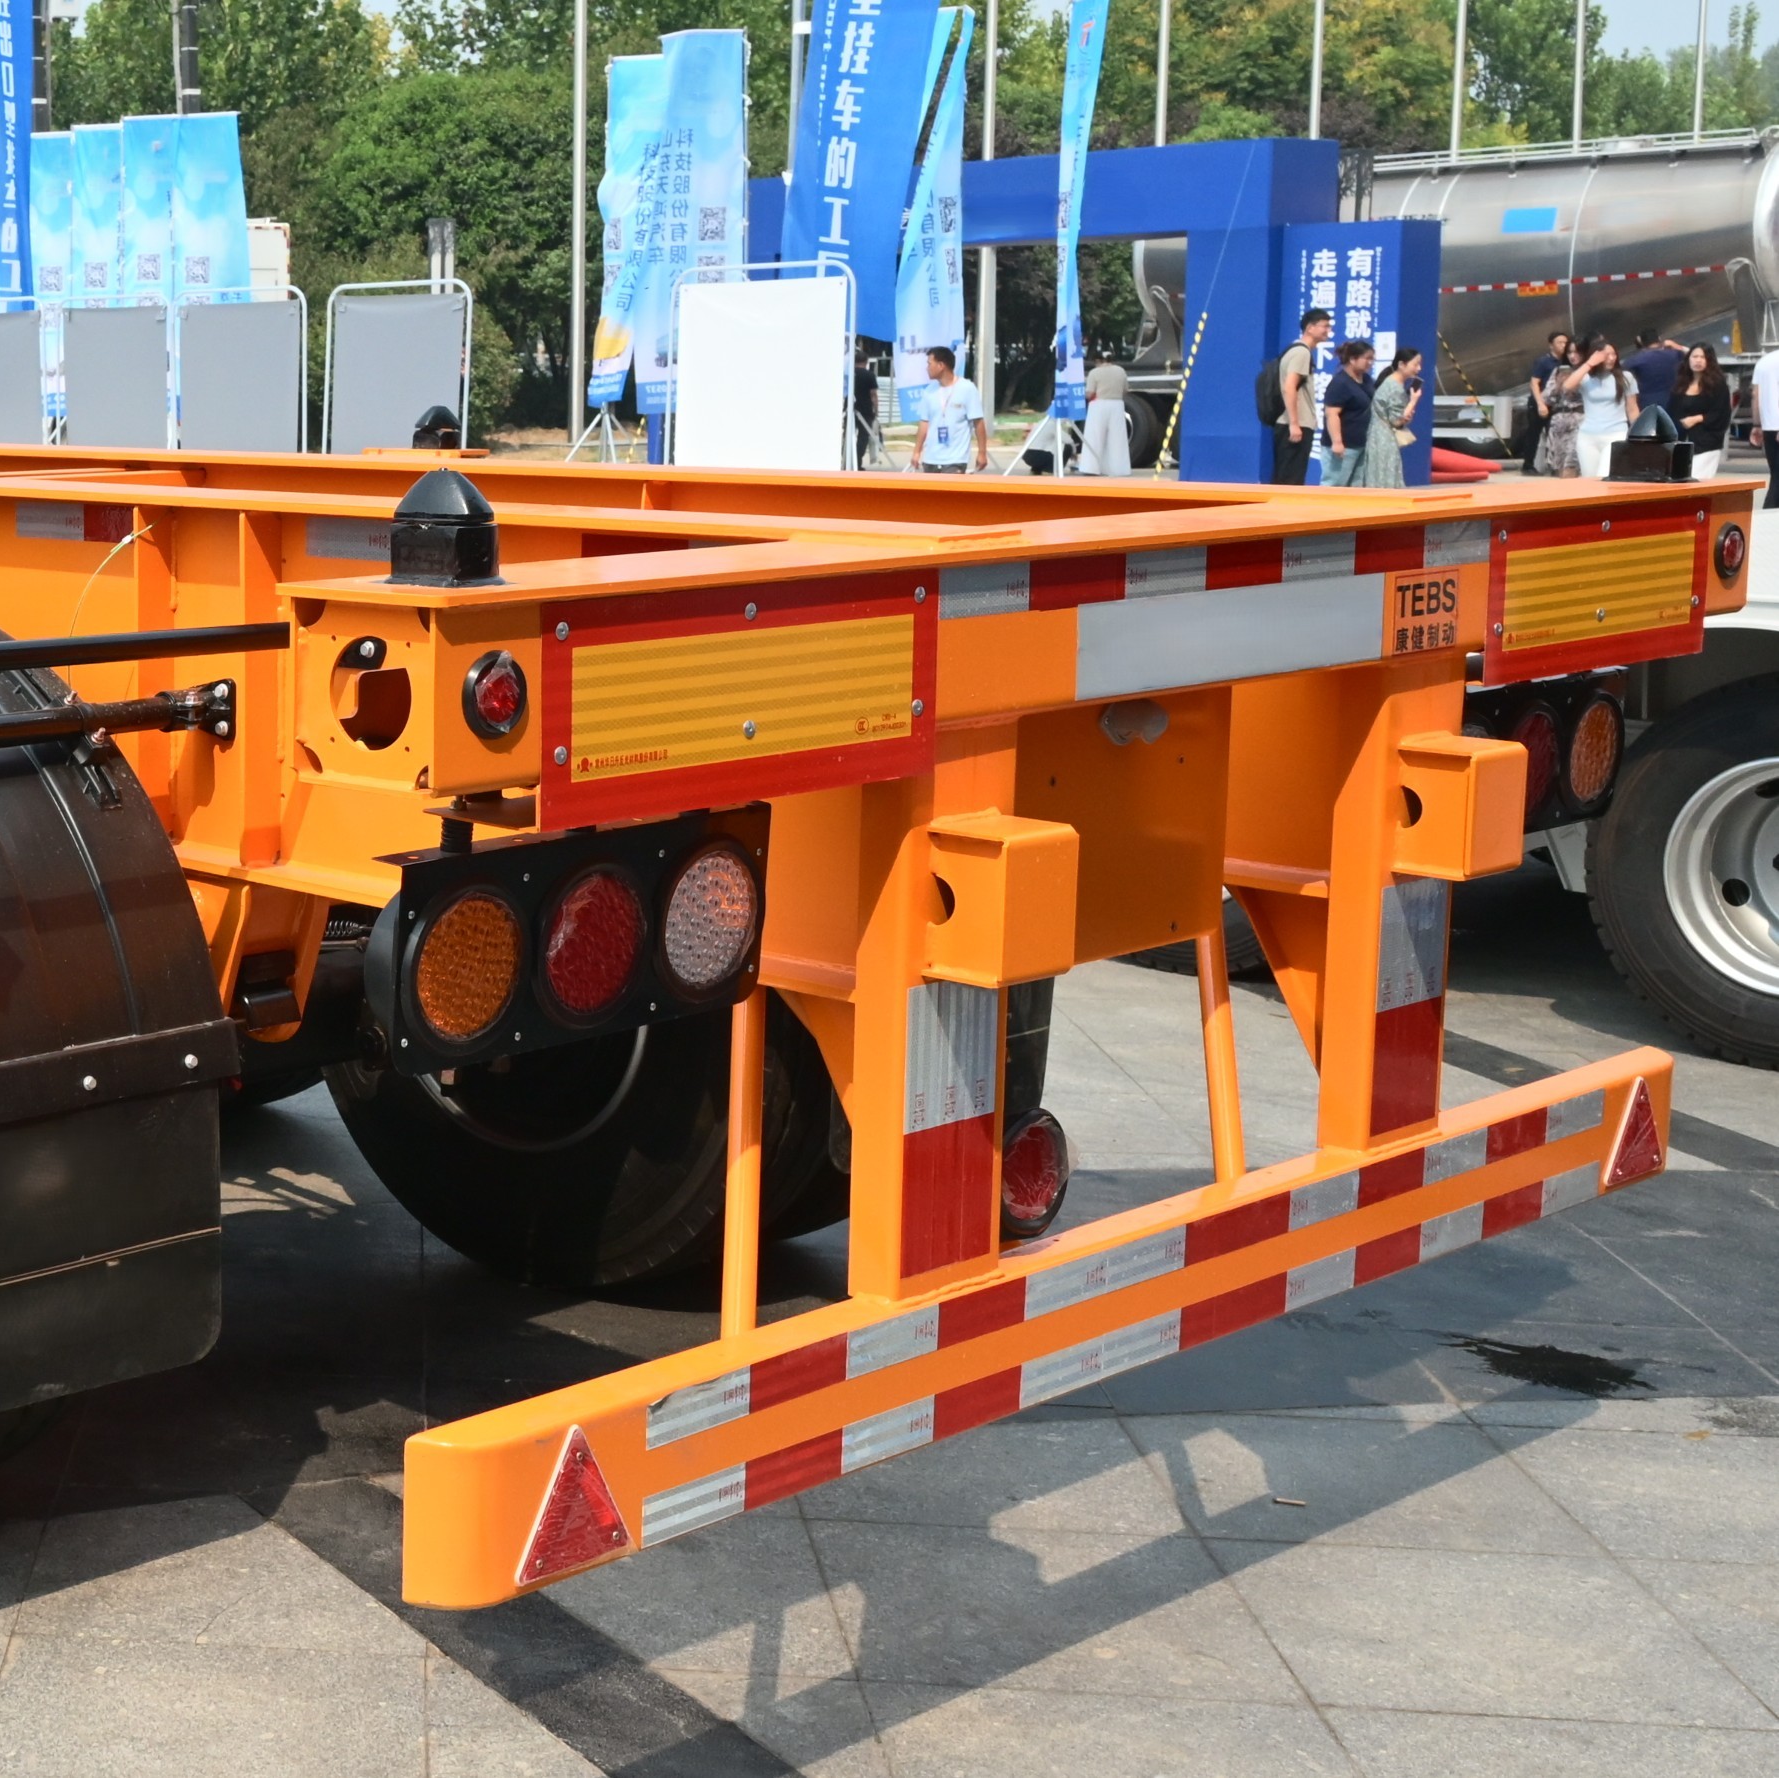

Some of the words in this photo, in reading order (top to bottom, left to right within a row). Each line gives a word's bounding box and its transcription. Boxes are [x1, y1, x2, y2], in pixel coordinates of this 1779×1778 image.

[1396, 578, 1457, 618] TEBS
[1395, 622, 1456, 653] 康健制动
